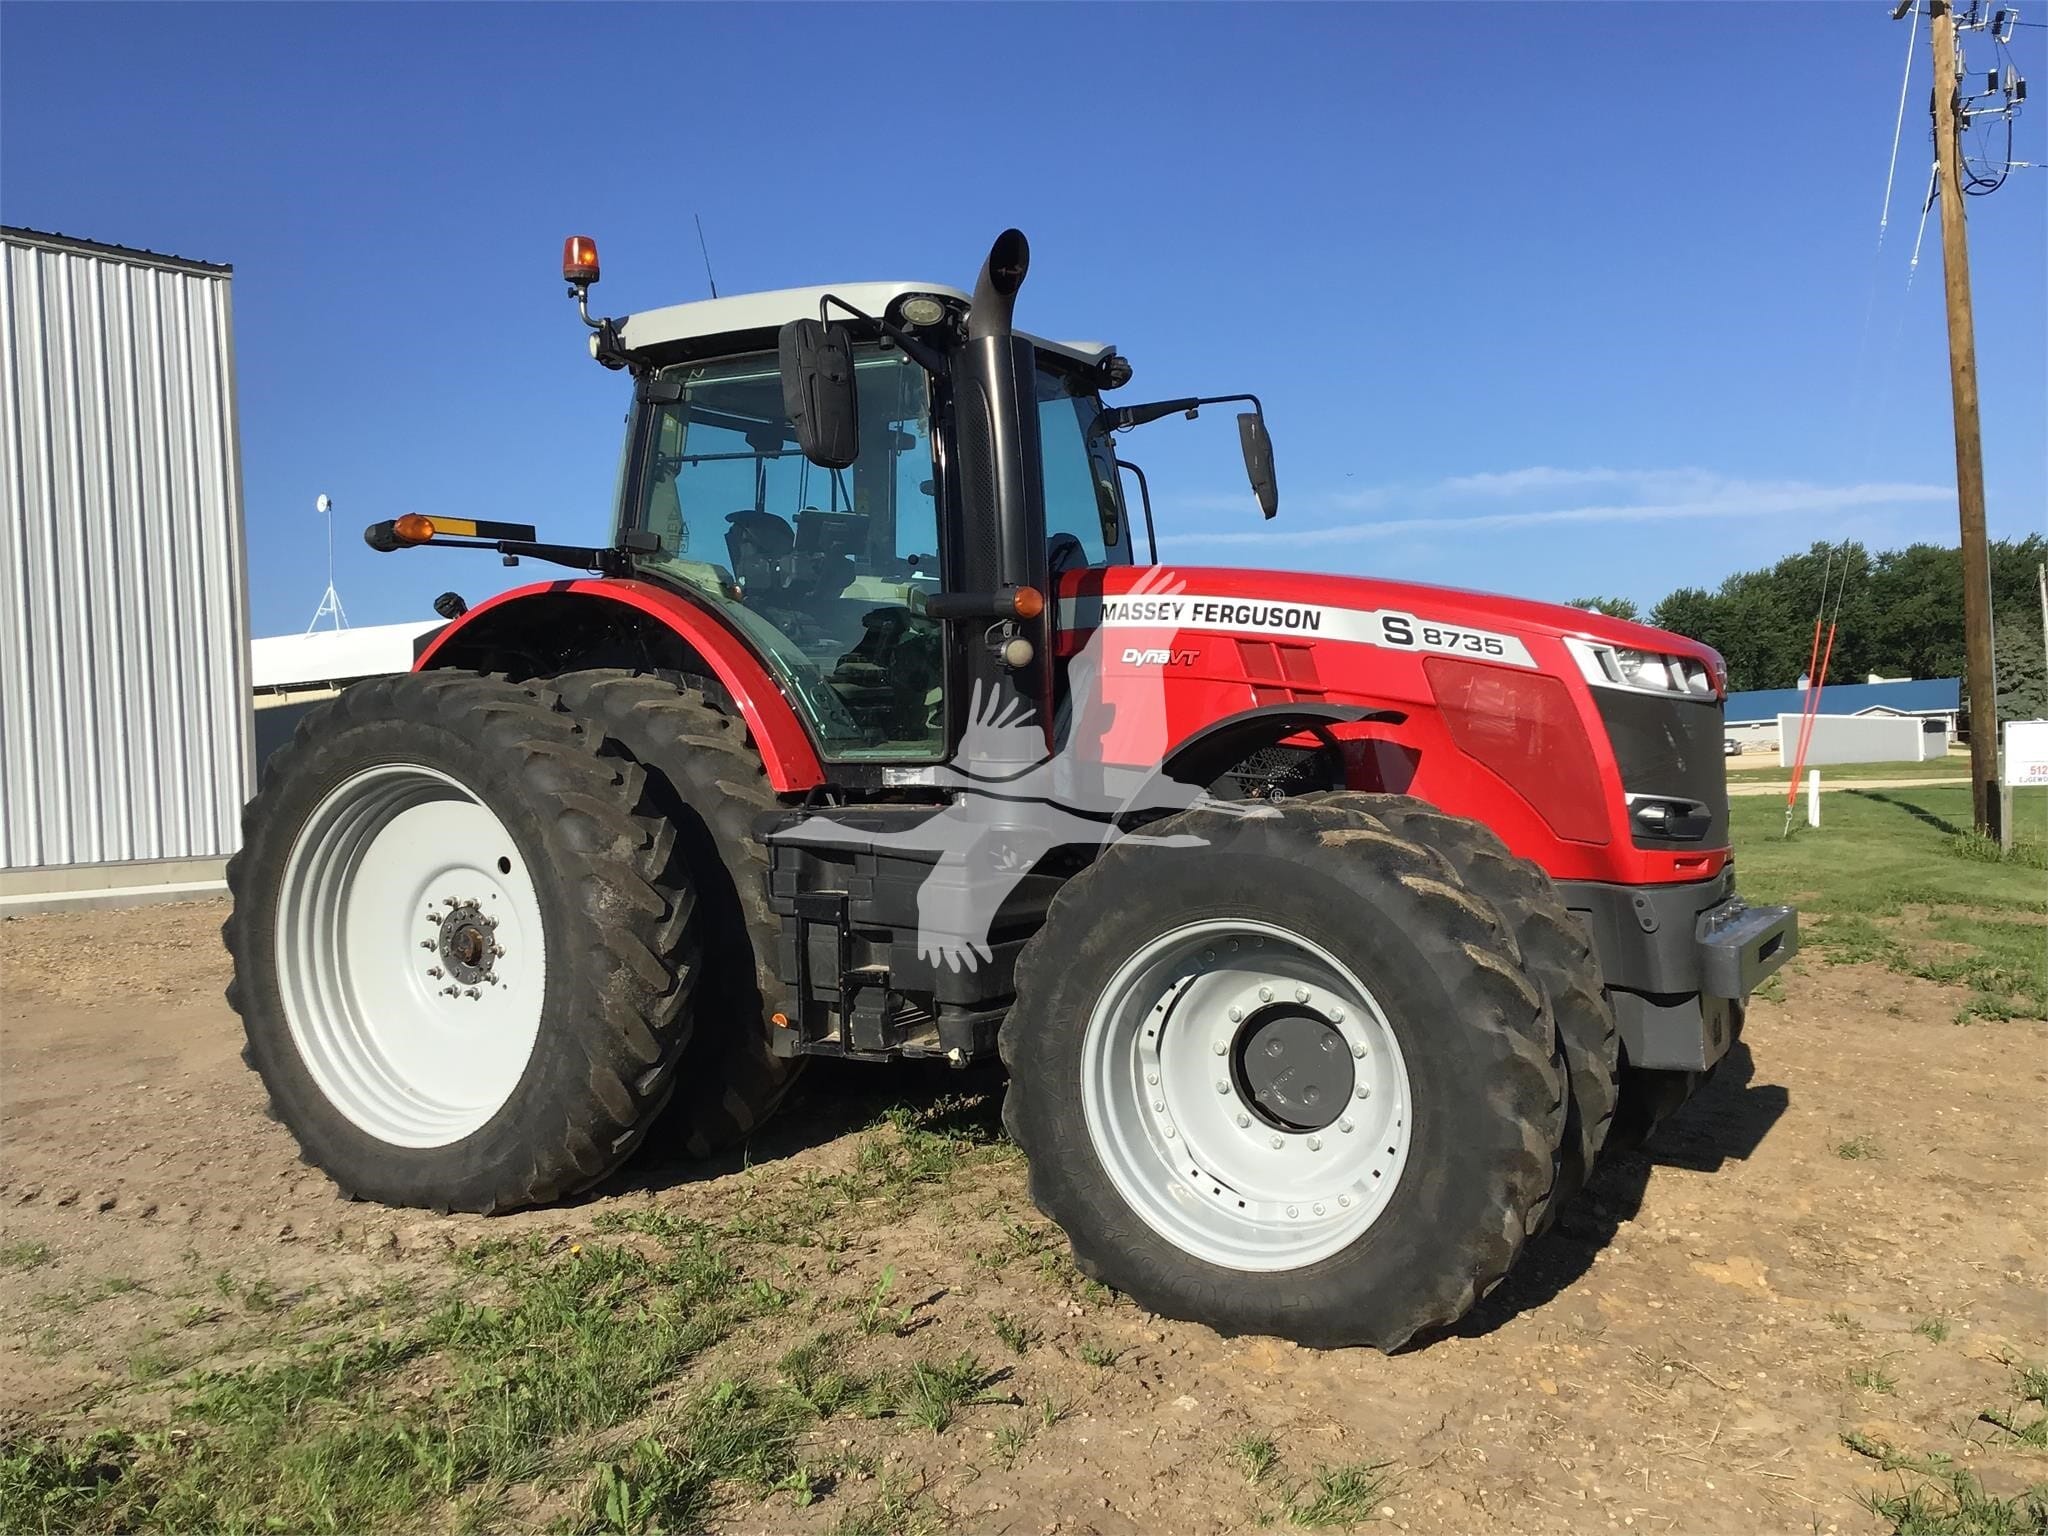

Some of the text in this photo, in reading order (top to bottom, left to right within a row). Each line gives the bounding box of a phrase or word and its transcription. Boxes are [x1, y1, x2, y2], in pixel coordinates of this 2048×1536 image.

[1100, 602, 1321, 630] MASSEY FERGUSON
[1382, 616, 1504, 655] S 8735
